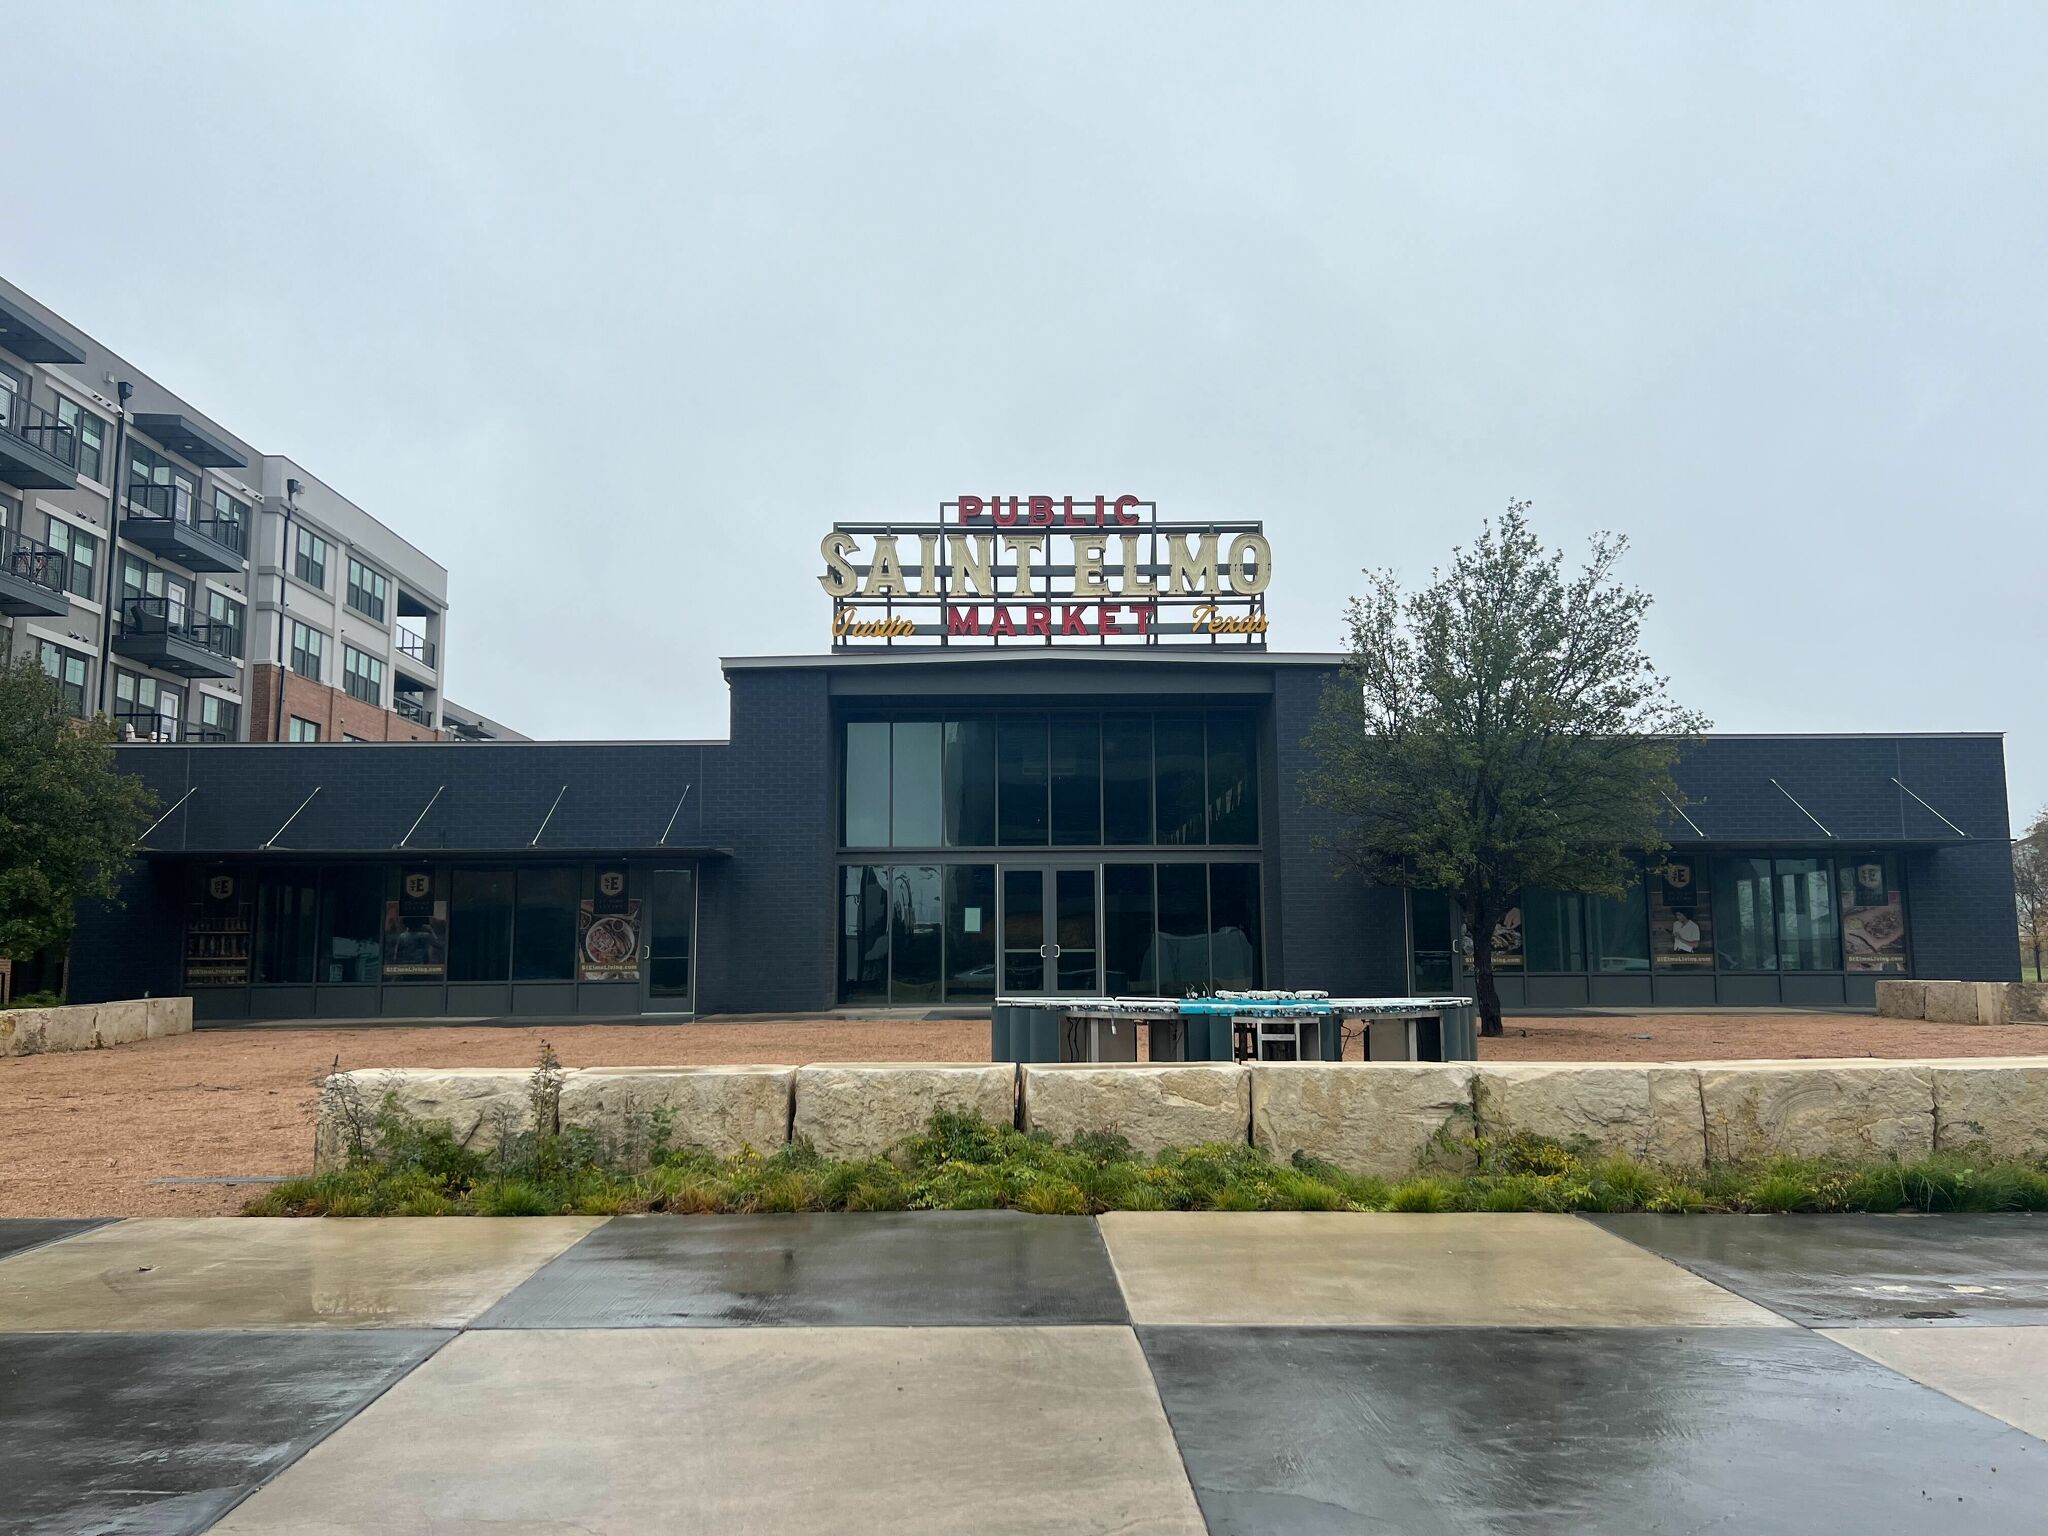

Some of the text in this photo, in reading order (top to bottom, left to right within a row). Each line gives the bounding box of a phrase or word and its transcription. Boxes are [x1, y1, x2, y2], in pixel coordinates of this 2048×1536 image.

[958, 495, 1140, 526] PUBLIC
[816, 531, 1273, 598] SAINT ELMO
[831, 606, 916, 637] Austin
[947, 605, 1156, 636] MARKET
[1192, 605, 1270, 634] Texas
